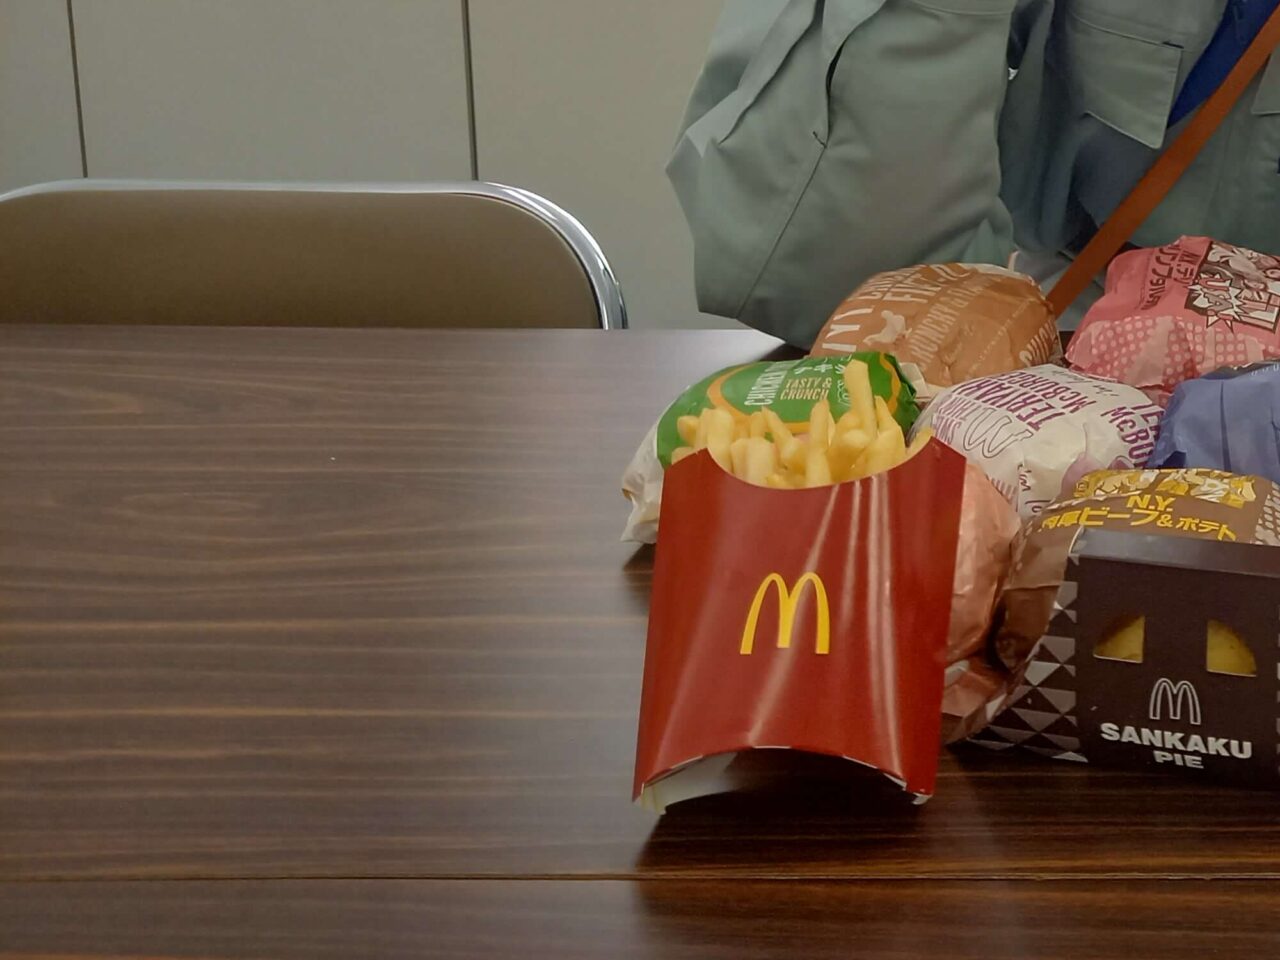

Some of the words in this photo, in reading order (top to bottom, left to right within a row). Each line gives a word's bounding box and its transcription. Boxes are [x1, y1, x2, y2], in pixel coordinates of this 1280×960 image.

[785, 378, 821, 389] TASTY
[822, 377, 832, 389] &
[1003, 370, 1097, 414] McBURGE
[1126, 494, 1175, 513] N.Y.
[1100, 722, 1252, 760] SANKAKU
[1153, 749, 1205, 770] PIE
